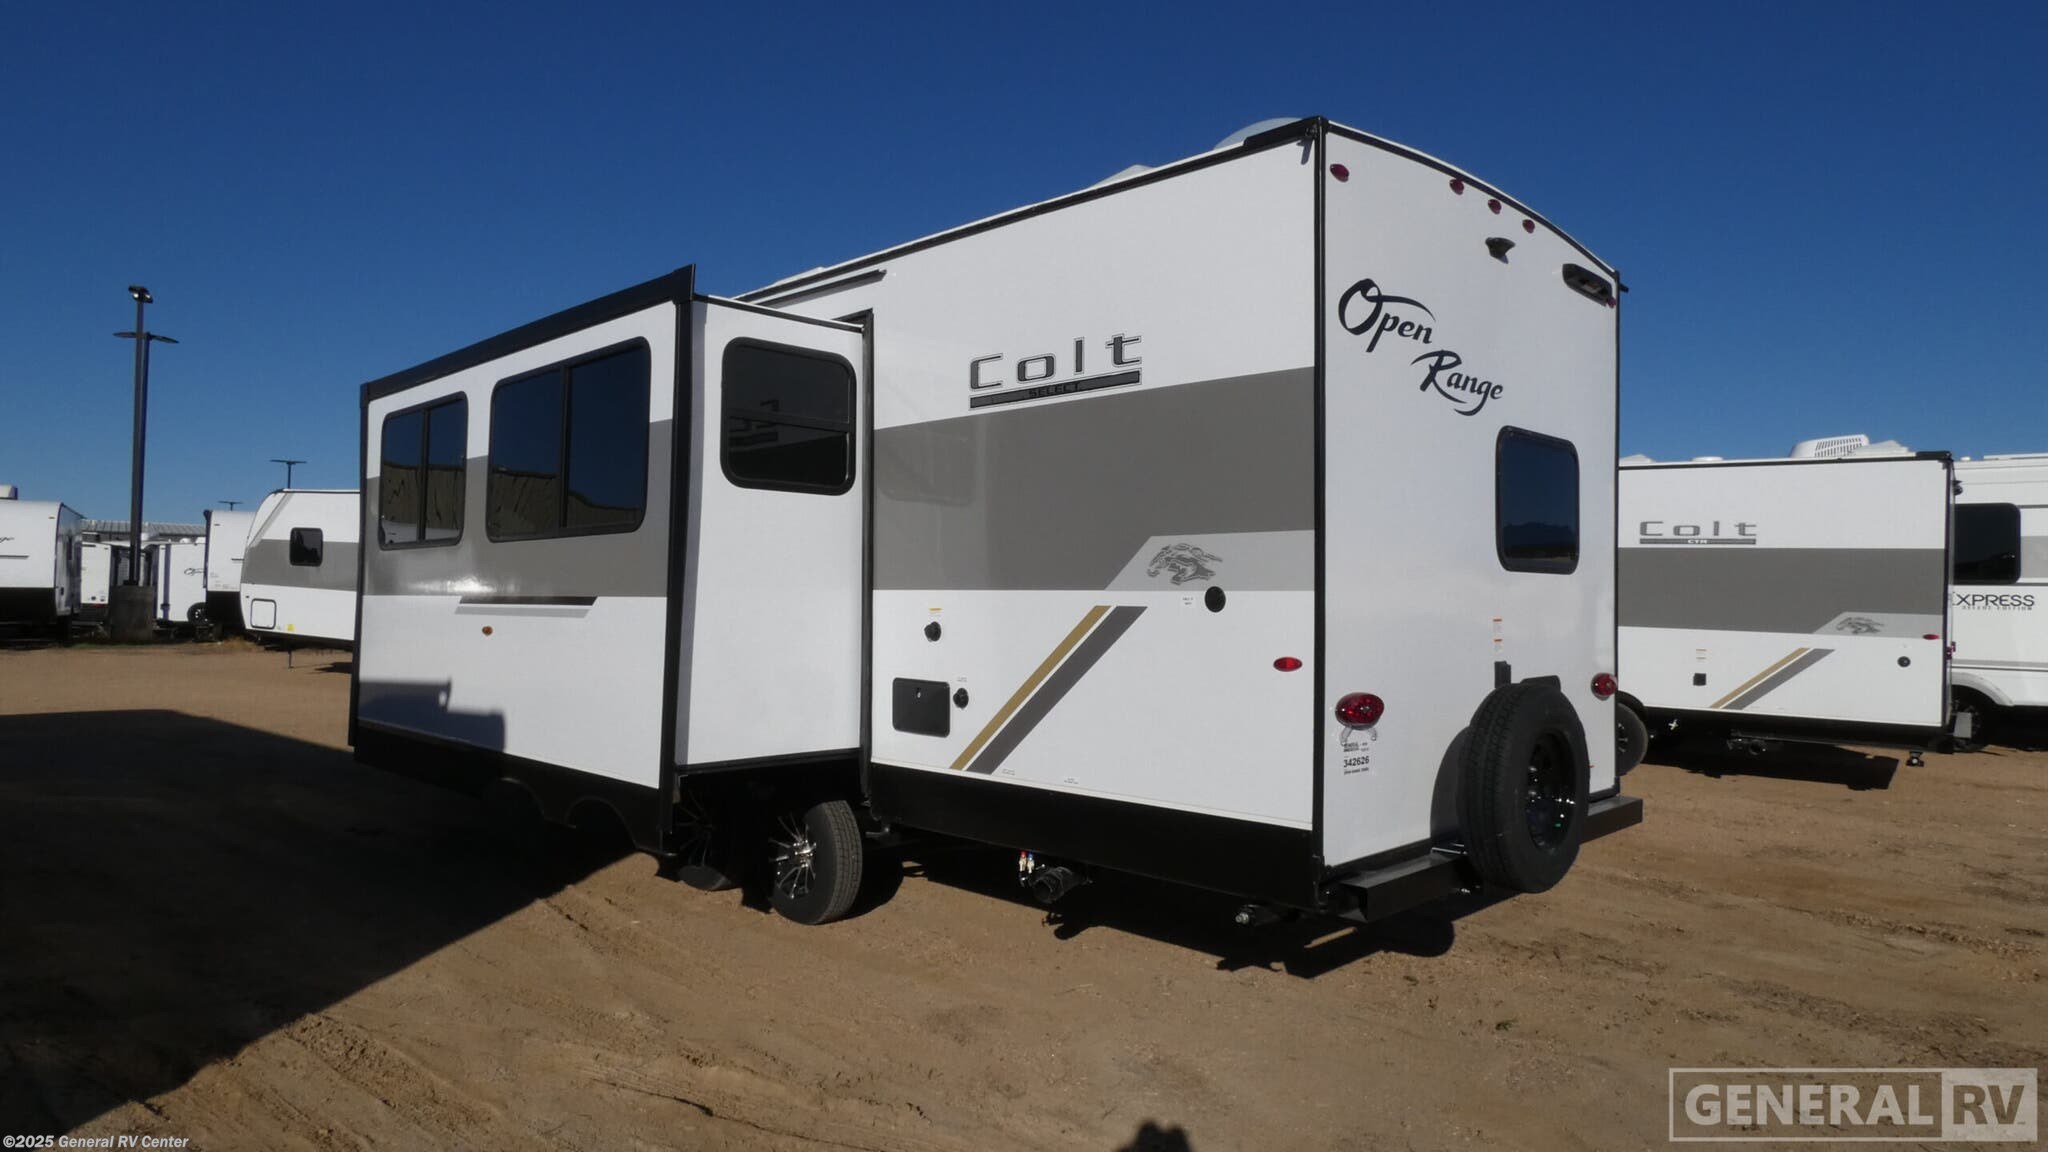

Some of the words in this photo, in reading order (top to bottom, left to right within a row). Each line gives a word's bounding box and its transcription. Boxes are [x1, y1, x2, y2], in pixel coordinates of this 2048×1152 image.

[1338, 278, 1436, 353] Open
[970, 333, 1142, 391] Colt
[1029, 382, 1080, 398] SELECT
[1410, 349, 1504, 417] Range
[1639, 520, 1757, 537] Colt
[1343, 756, 1370, 768] 342626
